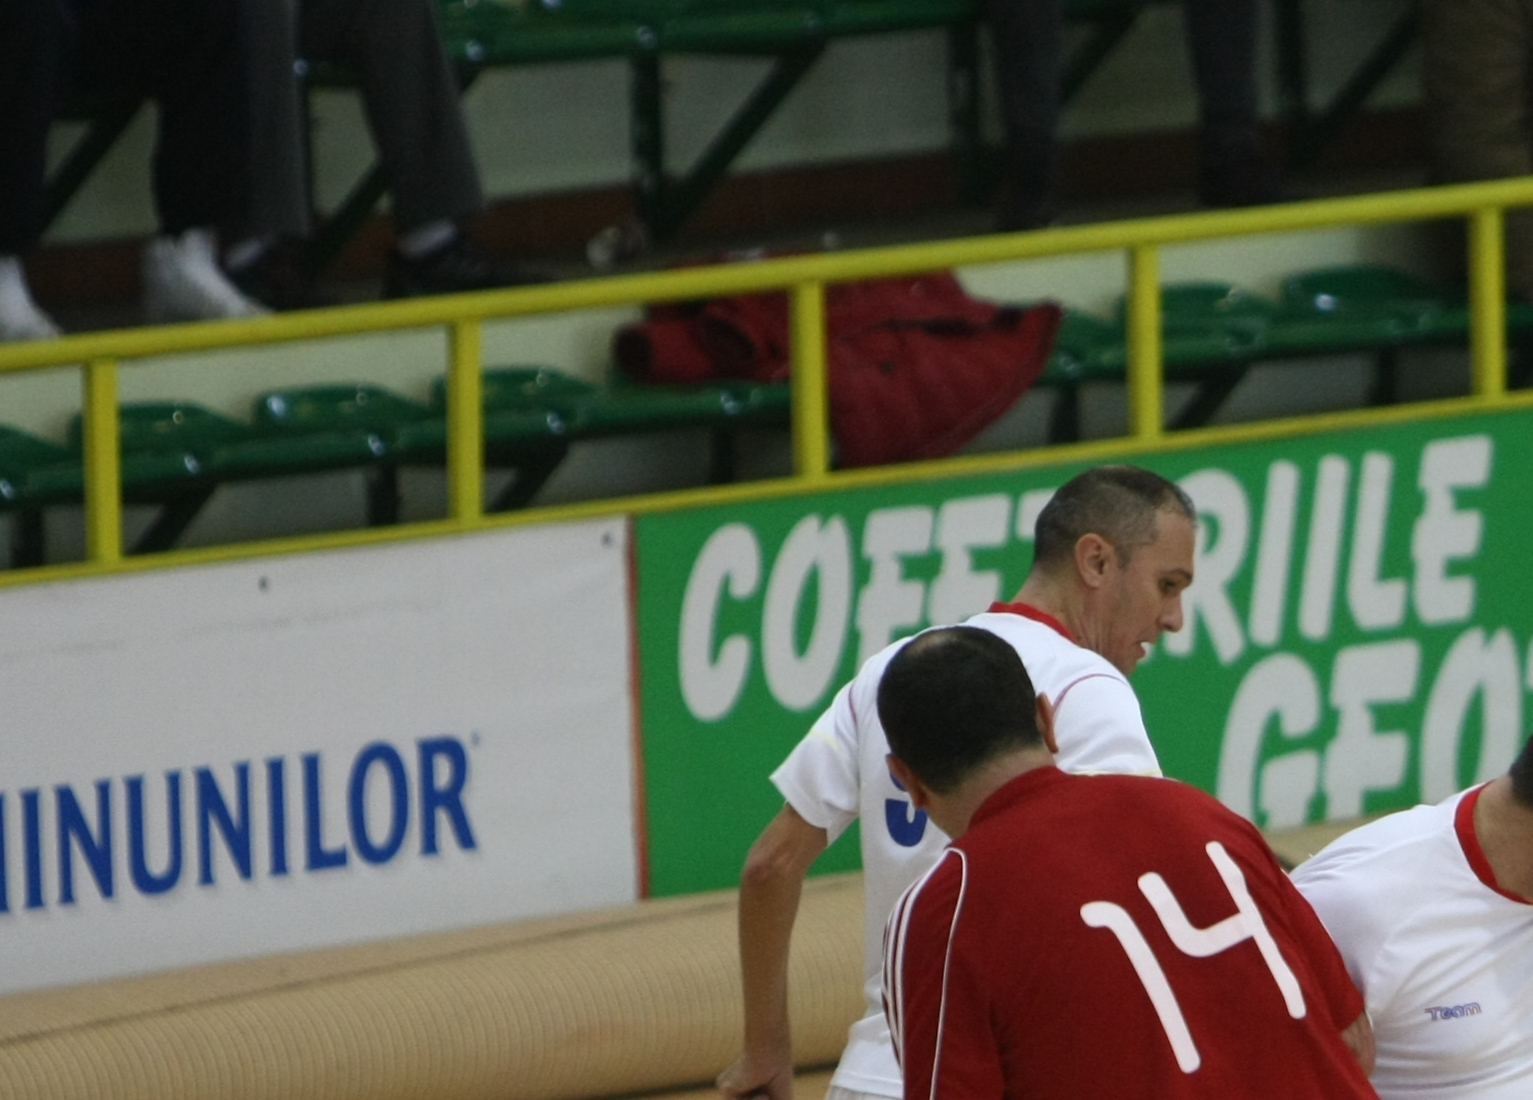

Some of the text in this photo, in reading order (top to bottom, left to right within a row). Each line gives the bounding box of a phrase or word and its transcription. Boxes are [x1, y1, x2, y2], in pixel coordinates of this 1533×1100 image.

[679, 434, 1492, 722] COFERIILE
[0, 736, 478, 914] INUNILOR
[1079, 840, 1307, 1074] 14
